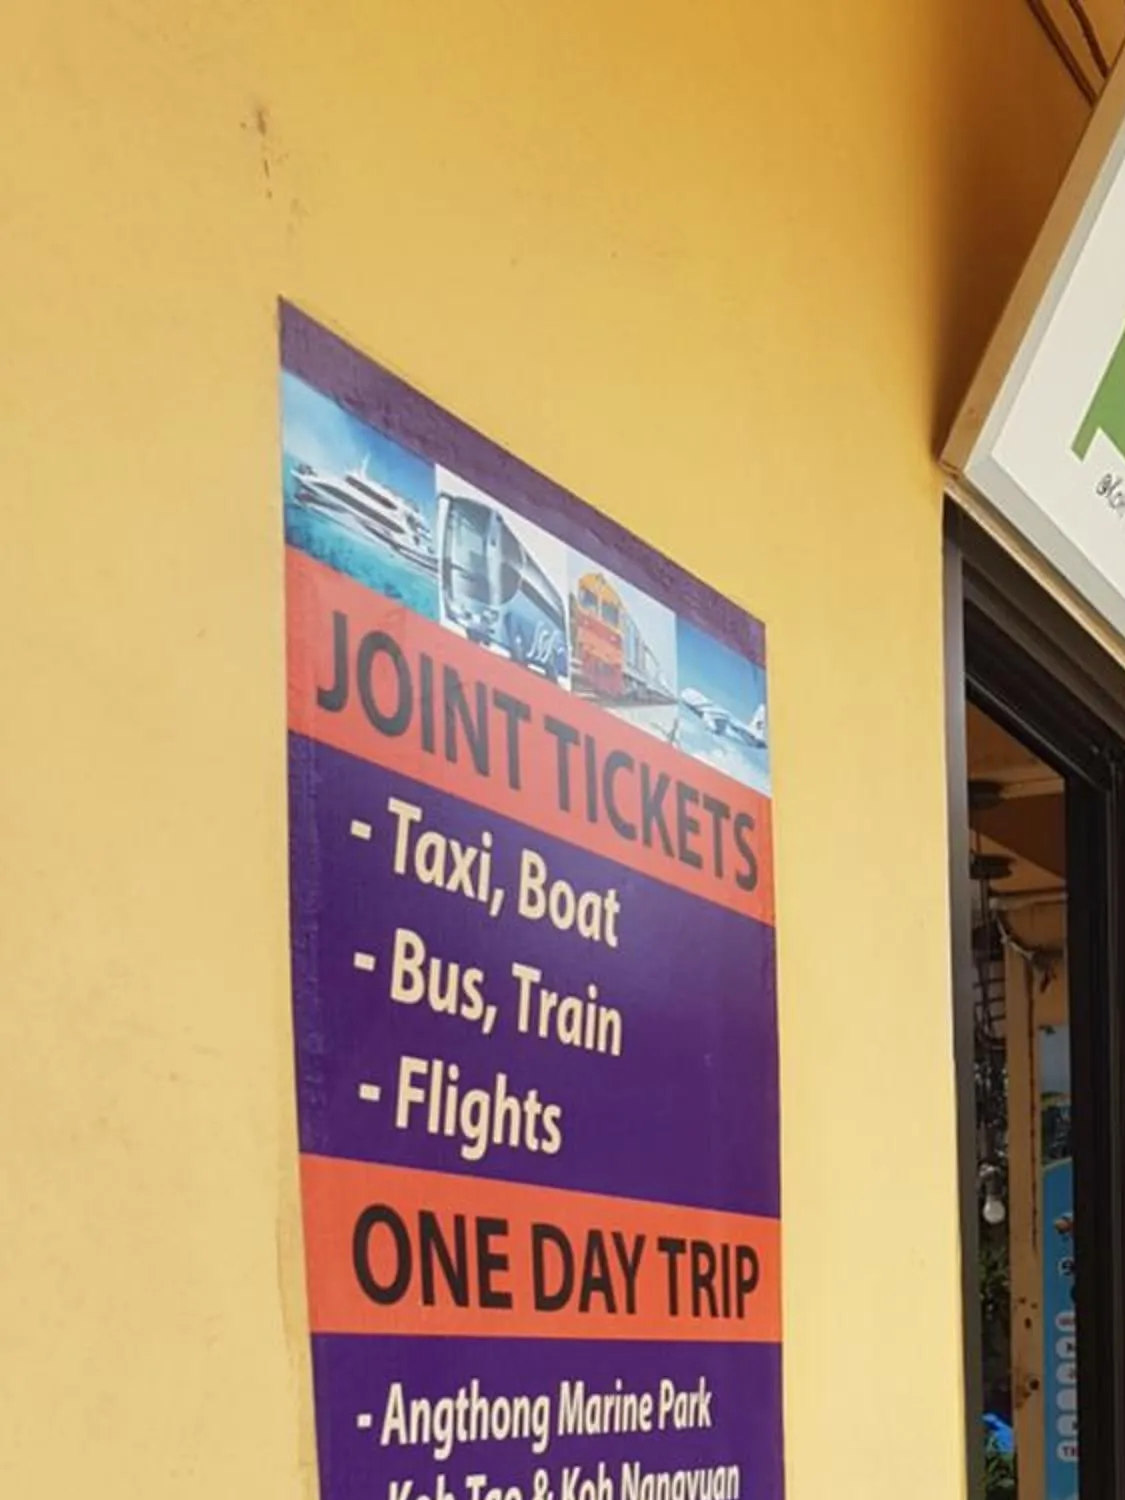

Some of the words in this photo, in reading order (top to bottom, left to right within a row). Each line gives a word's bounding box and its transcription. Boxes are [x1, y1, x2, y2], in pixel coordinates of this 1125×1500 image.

[316, 610, 531, 791] JOINT
[544, 714, 758, 892] TICKETS
[388, 797, 504, 917] Taxi,
[518, 849, 620, 948] Boat
[390, 928, 496, 1035] Bus,
[512, 962, 622, 1056] Train
[396, 1056, 562, 1161] Flights
[353, 1204, 513, 1311] ONE
[531, 1223, 646, 1314] DAY
[657, 1237, 760, 1319] TRIP
[380, 1379, 550, 1461] Angthong
[558, 1379, 653, 1435] Marine
[659, 1375, 712, 1430] Park
